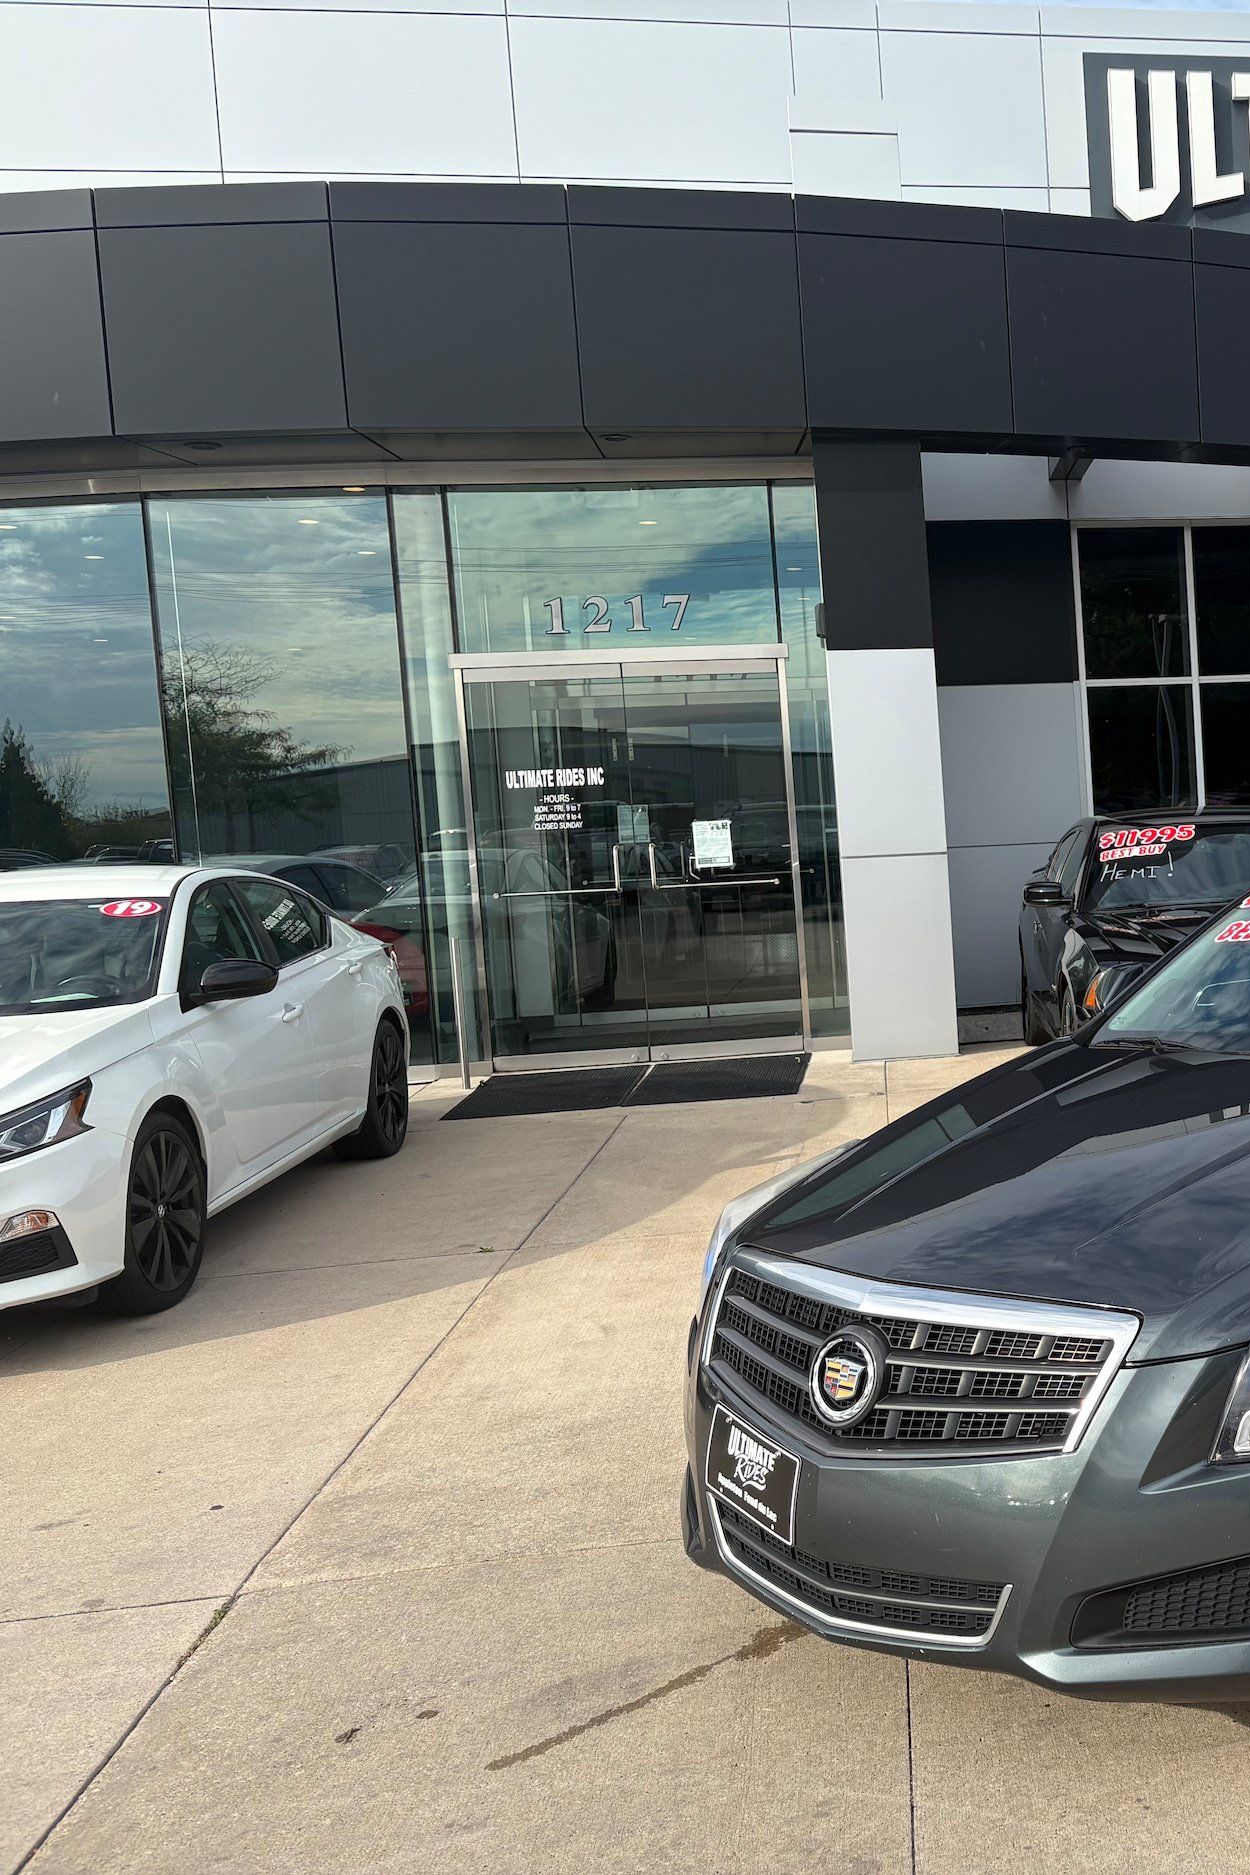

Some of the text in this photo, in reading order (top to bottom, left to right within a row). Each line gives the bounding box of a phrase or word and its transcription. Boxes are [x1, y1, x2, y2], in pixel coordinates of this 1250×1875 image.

[542, 593, 691, 635] 1217
[505, 766, 605, 789] ULTIMATE RIDES INC
[543, 794, 570, 804] HOURS
[534, 814, 566, 822] SATURDAY
[534, 821, 583, 830] CLOSED SUNDAY
[1100, 825, 1195, 849] $11995
[1100, 844, 1166, 861] BEST BUY
[112, 901, 152, 914] 19
[728, 1425, 775, 1472] ULTIMATE
